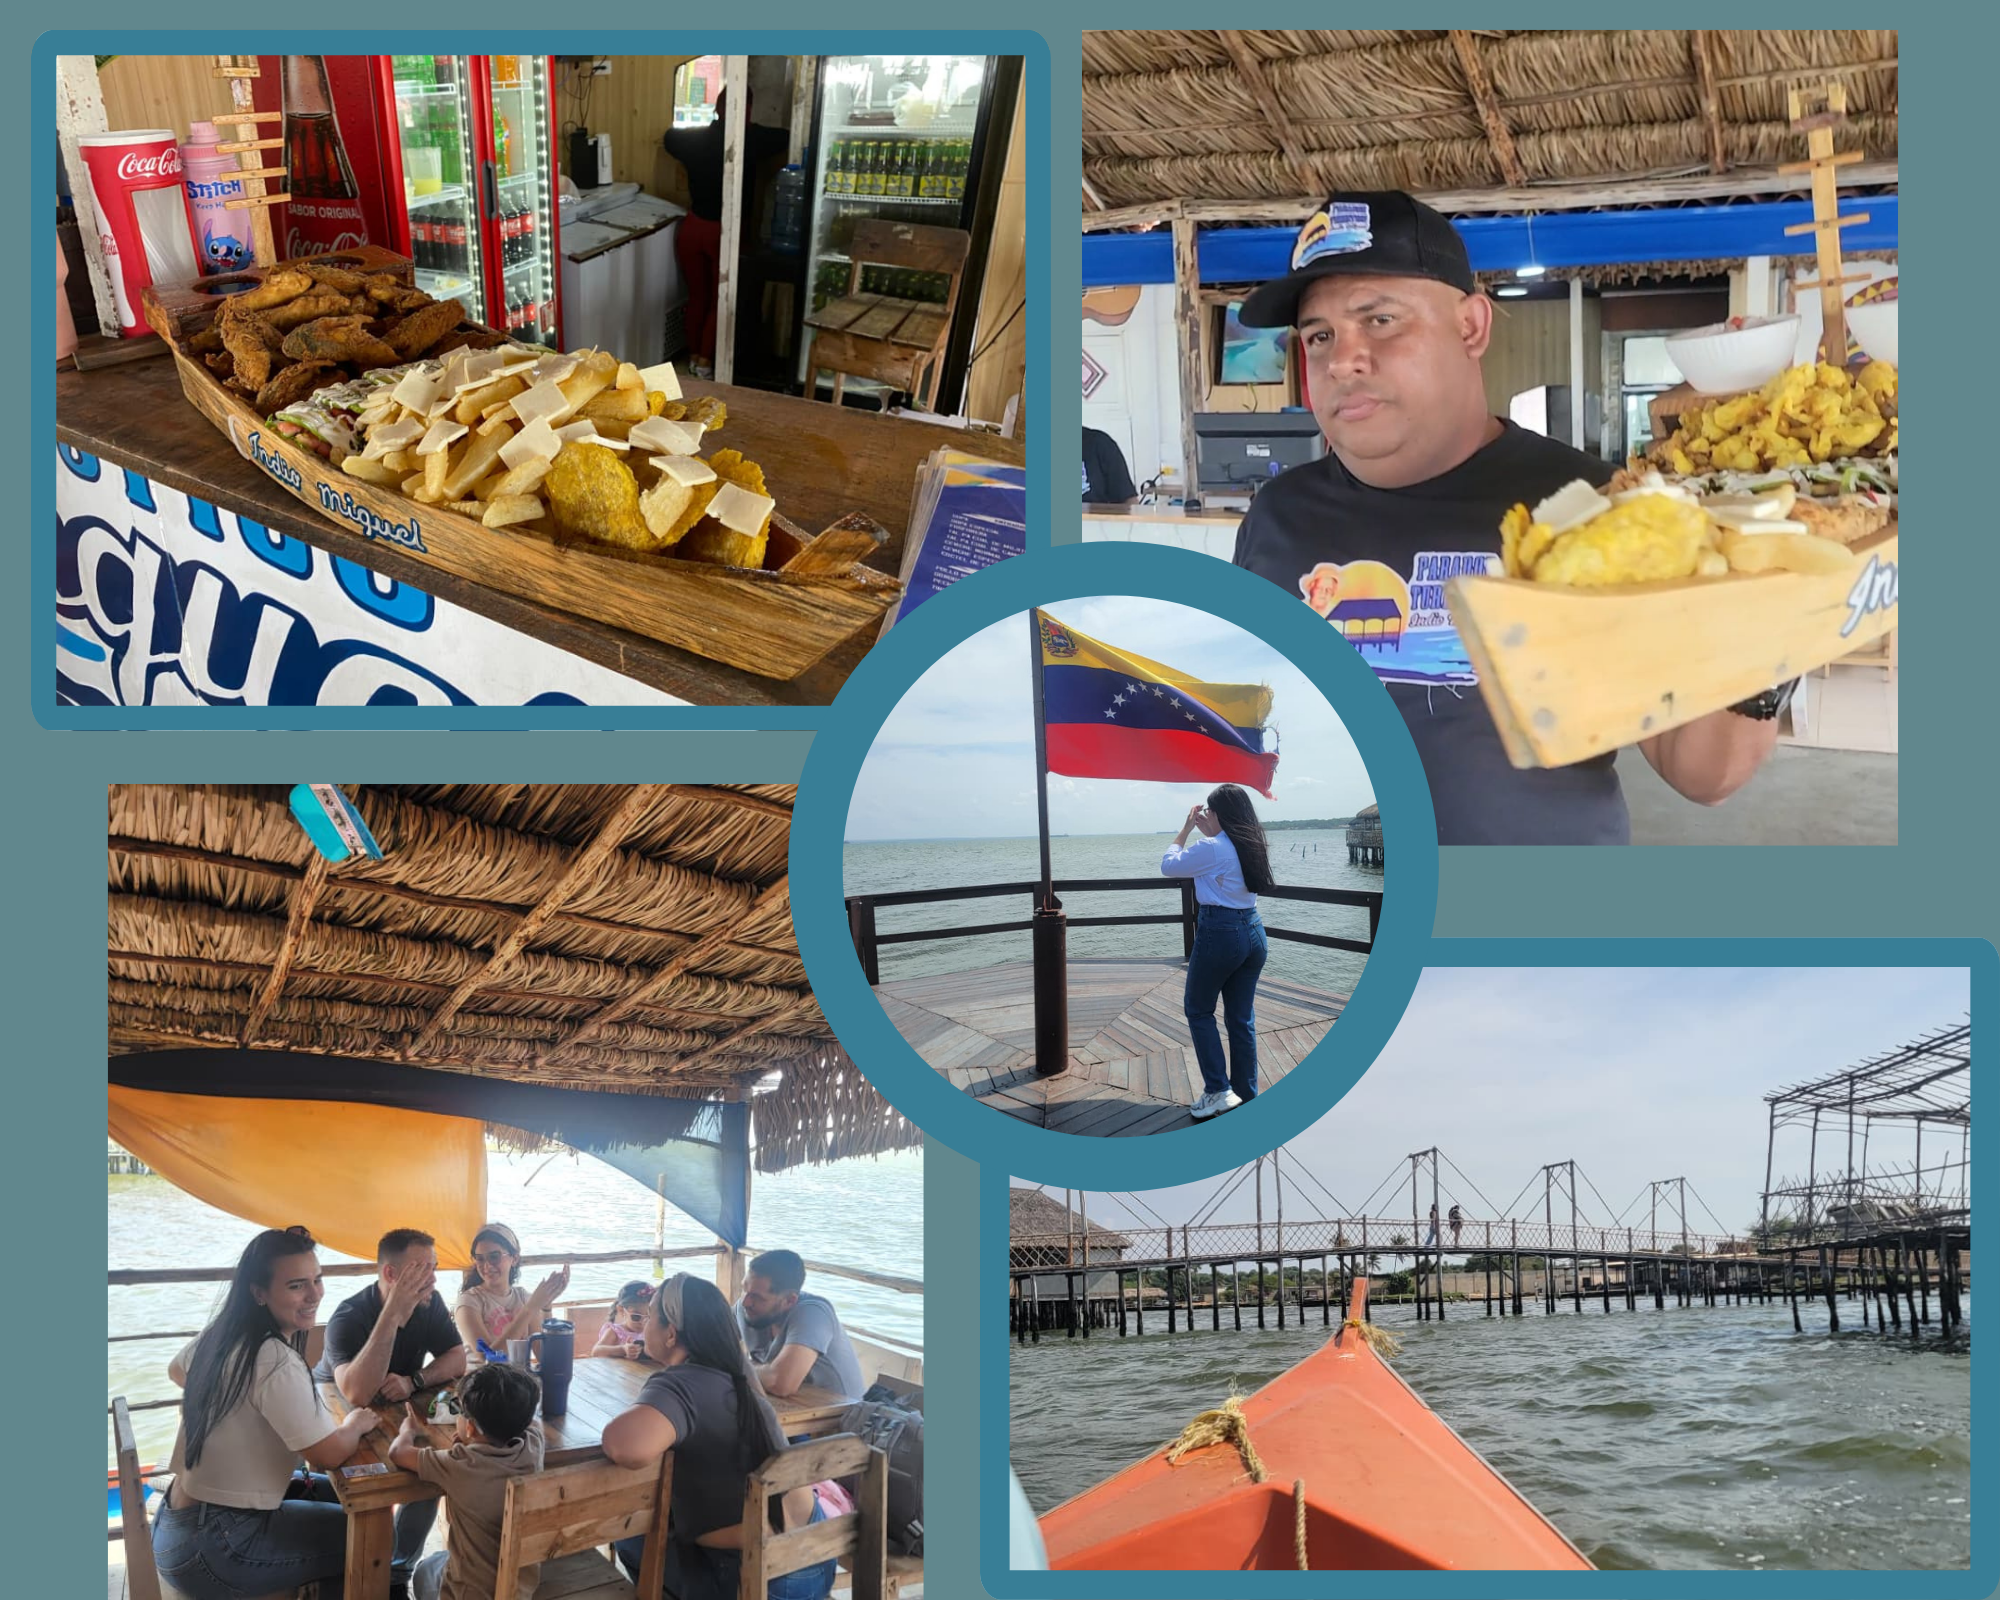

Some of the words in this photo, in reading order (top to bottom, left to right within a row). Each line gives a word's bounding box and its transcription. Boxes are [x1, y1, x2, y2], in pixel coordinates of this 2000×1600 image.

[288, 203, 316, 217] SABOR
[318, 206, 362, 219] ORIGINAL
[248, 431, 302, 492] Indio
[316, 482, 428, 554] Miguel
